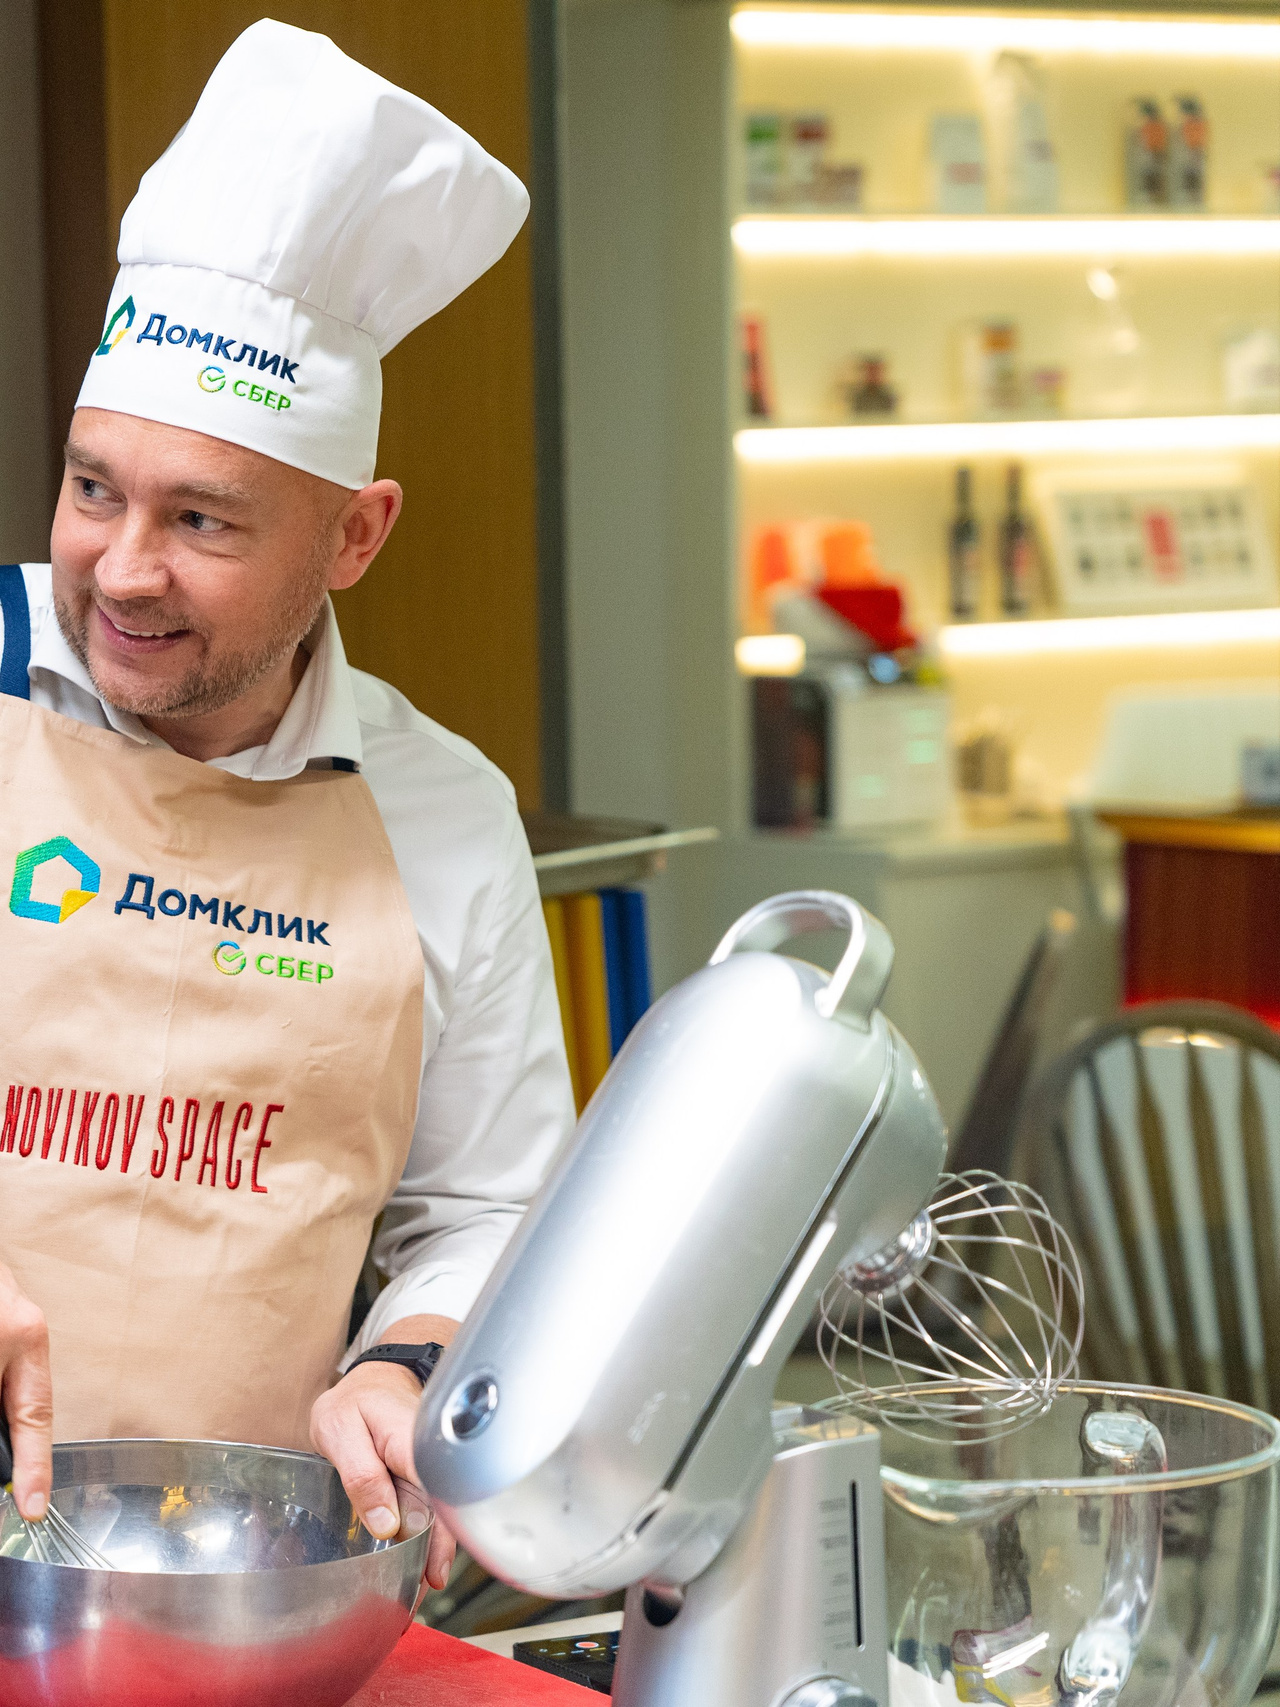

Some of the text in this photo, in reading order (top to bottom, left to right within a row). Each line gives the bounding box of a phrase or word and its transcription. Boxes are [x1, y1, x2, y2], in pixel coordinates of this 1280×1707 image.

[232, 381, 291, 411] СБЕР
[255, 952, 334, 984] СБЕР
[0, 1085, 285, 1193] NOVIKOV SPACE
